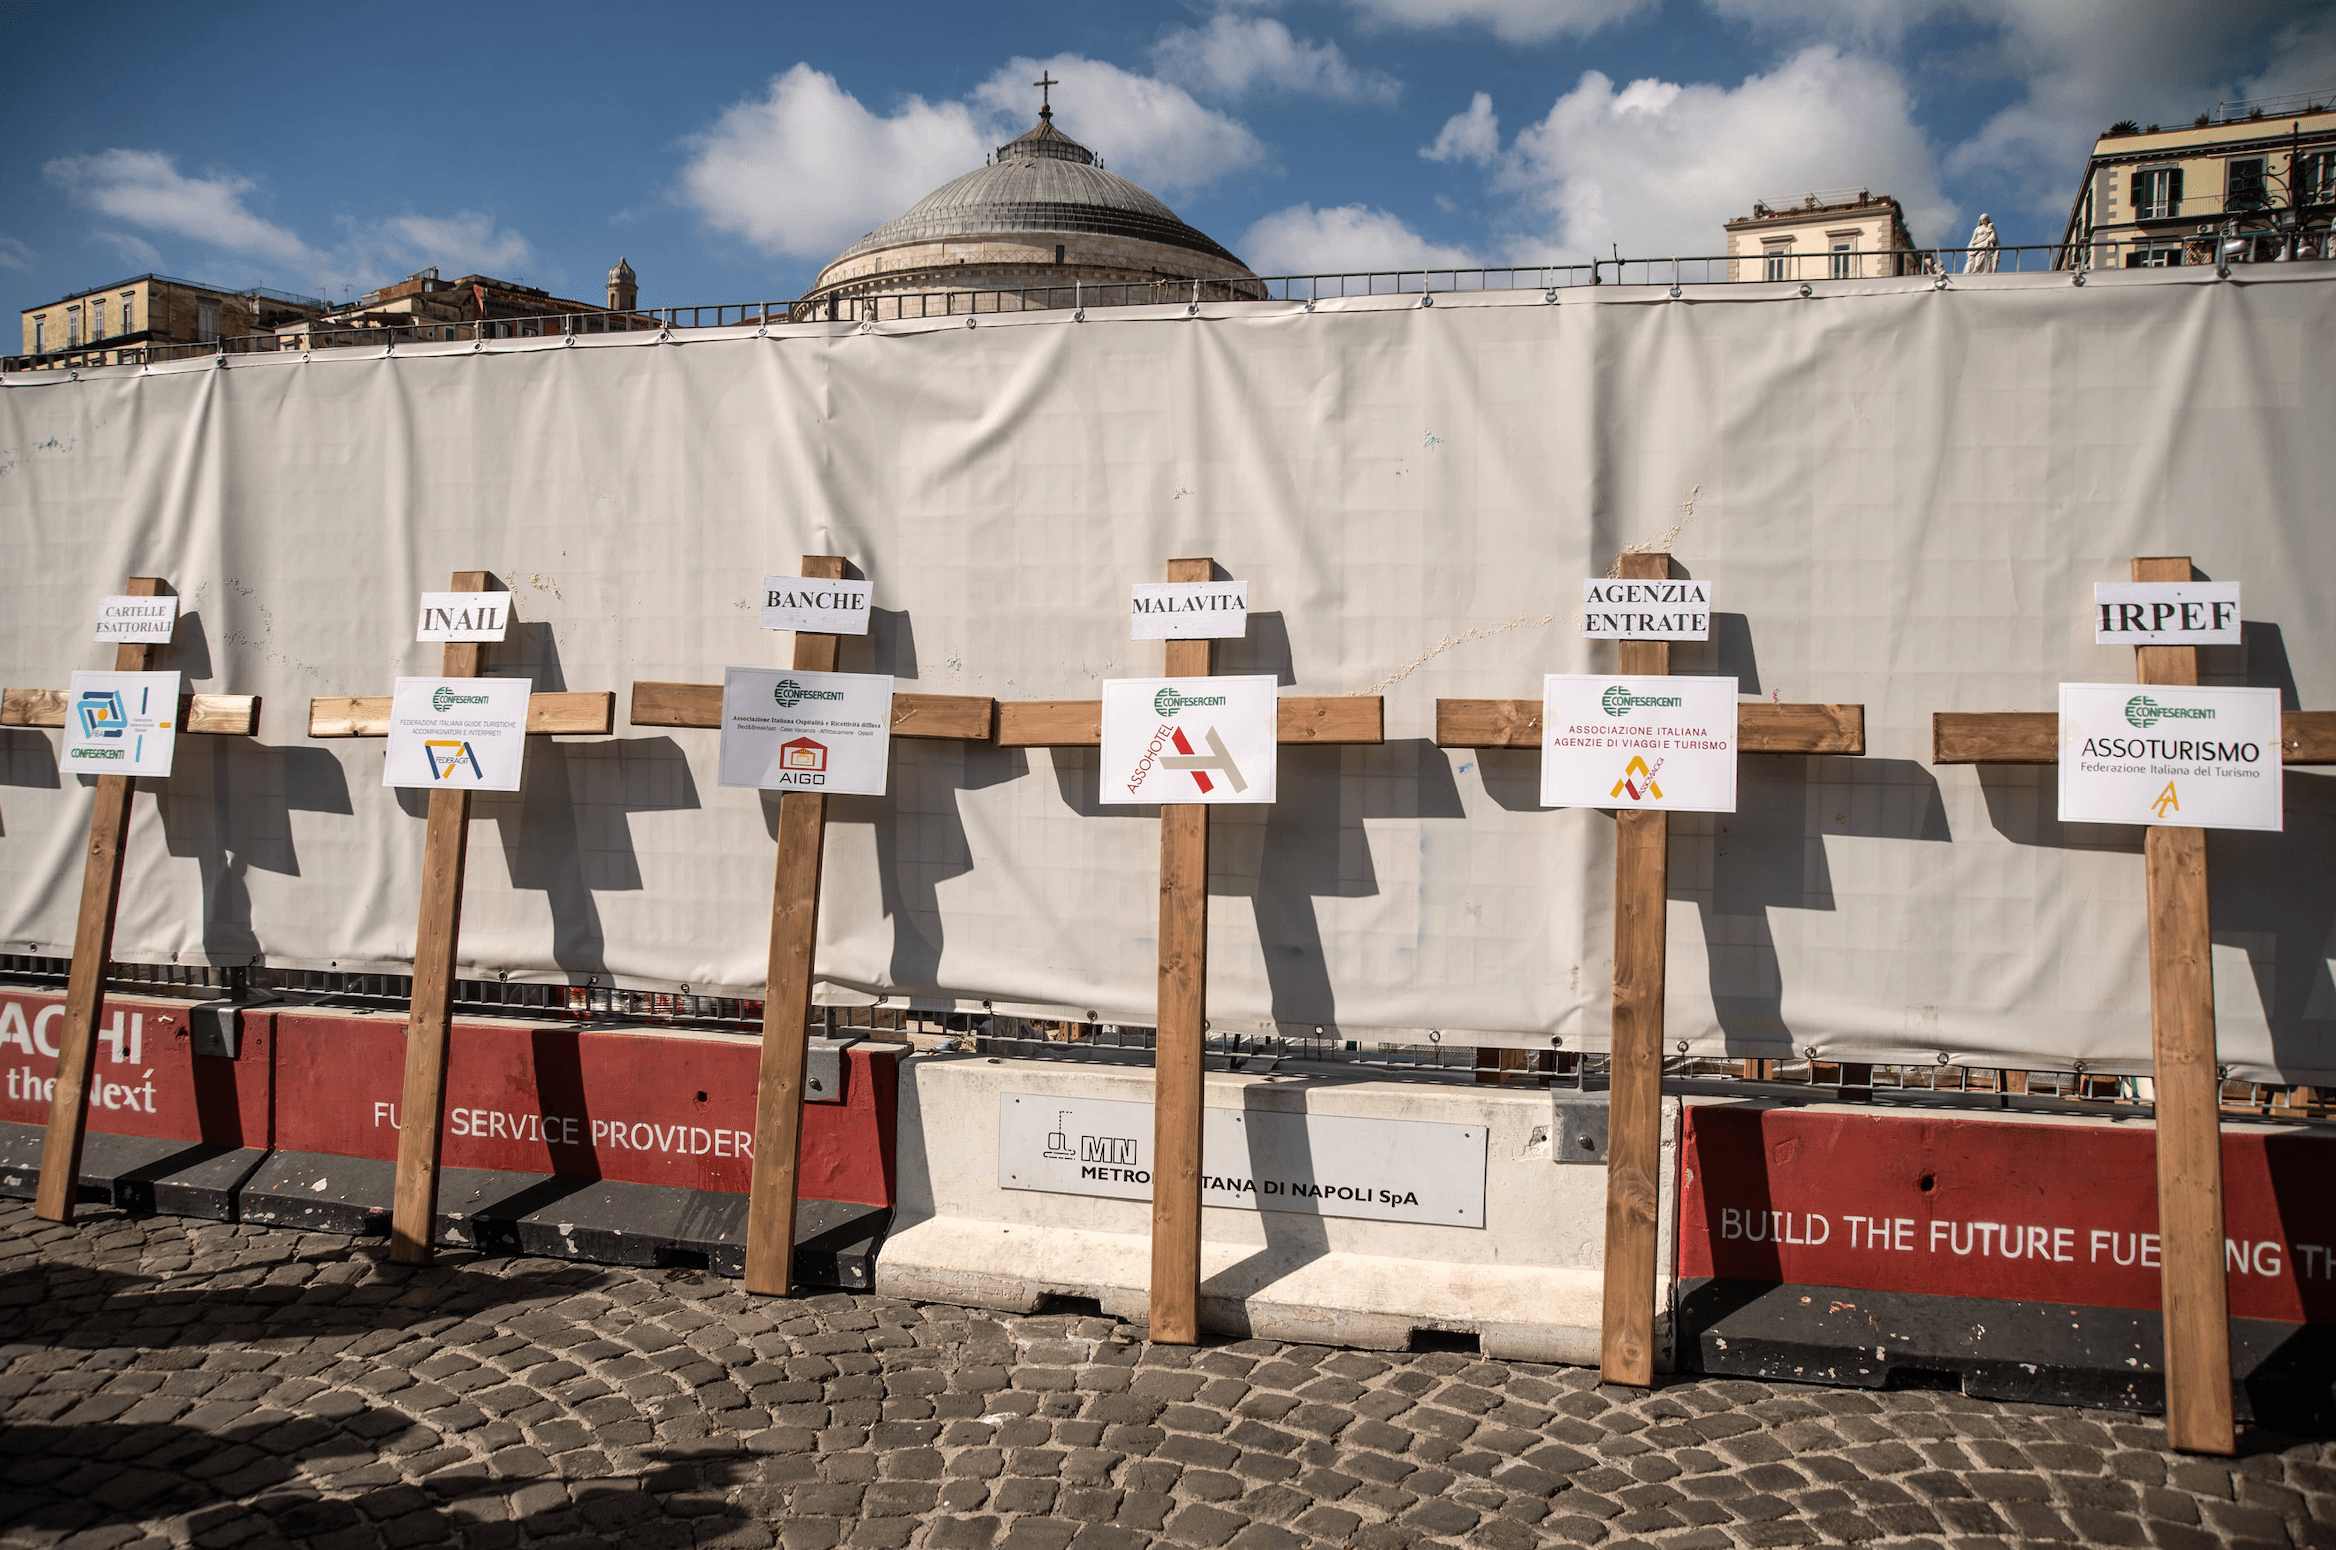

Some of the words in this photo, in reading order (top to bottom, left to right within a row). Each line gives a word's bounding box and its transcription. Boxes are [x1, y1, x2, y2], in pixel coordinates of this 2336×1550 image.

[767, 590, 864, 611] BANCHE
[1587, 585, 1706, 603] AGENZIA
[105, 606, 167, 617] CARTELLE
[1132, 594, 1246, 614] MALAVITA
[422, 608, 504, 631] INAIL
[1586, 613, 1706, 632] ENTRATE
[2098, 601, 2236, 632] IRPEF
[440, 695, 490, 705] CONFESERCENTI
[783, 689, 845, 702] CONFESERCENTI
[1162, 696, 1227, 707] CONFESERCENTI
[1611, 696, 1682, 708] CONFESERCENTI
[732, 715, 770, 723] Associazione
[2135, 706, 2216, 720] CONFESERCENTI
[412, 728, 462, 736] ACCOMPAGNATORI
[468, 729, 502, 737] INTERPRETI
[1568, 725, 1654, 737] ASSOCIAZIONE
[1657, 727, 1708, 738] ITALIANA
[1553, 737, 1603, 748] AGENZIE
[1607, 738, 1619, 748] DI
[1622, 739, 1661, 749] VIAGGI
[1663, 740, 1671, 749] E
[1675, 740, 1728, 751] TURISMO
[2081, 738, 2260, 763] ASSOTURISMO
[70, 748, 126, 760] CONFESERCENTI
[435, 756, 470, 765] FEDERAGIT
[1126, 724, 1174, 795] ASSOHOTEL
[779, 772, 826, 785] AIGO
[2080, 761, 2147, 774] Federazione
[2150, 763, 2190, 776] Italiana
[2194, 765, 2212, 776] del
[2215, 766, 2261, 779] Turismo
[0, 1001, 143, 1064] ACHI
[450, 1107, 579, 1146] SERVICE
[592, 1119, 755, 1160] PROVIDER
[1080, 1135, 1138, 1166] MN
[1263, 1179, 1286, 1196] DI
[1291, 1181, 1373, 1203] NAPOLI
[1379, 1188, 1420, 1208] SpA
[1720, 1207, 1830, 1246] BUILD
[1843, 1215, 1915, 1252] THE
[1929, 1220, 2074, 1263] FUTURE
